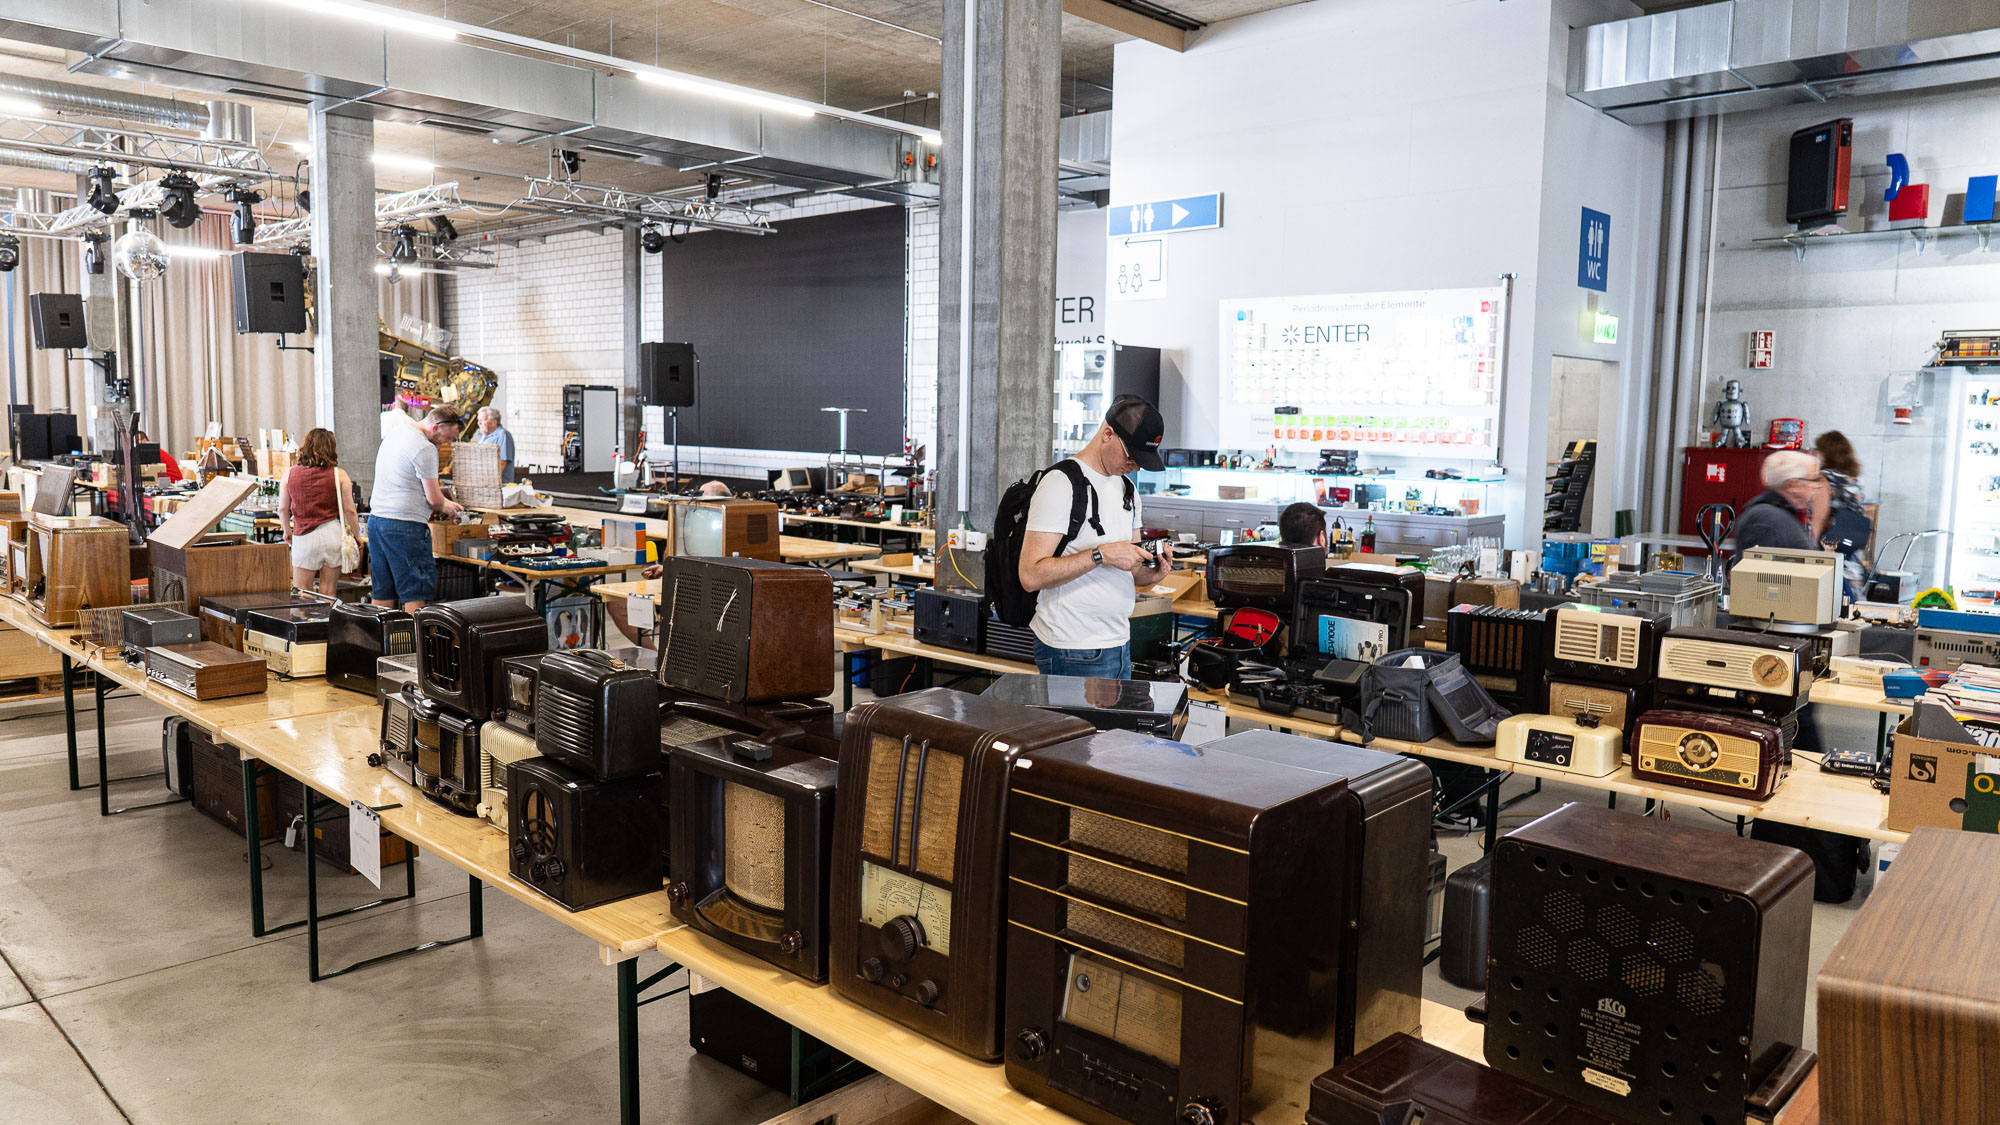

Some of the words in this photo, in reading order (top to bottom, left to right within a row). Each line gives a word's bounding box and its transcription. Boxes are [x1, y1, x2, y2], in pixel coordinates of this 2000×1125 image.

[1587, 260, 1601, 280] WC
[1056, 296, 1094, 323] ER
[1381, 300, 1425, 309] Elemente
[1304, 324, 1370, 343] ENTER
[1597, 998, 1626, 1018] EKCO
